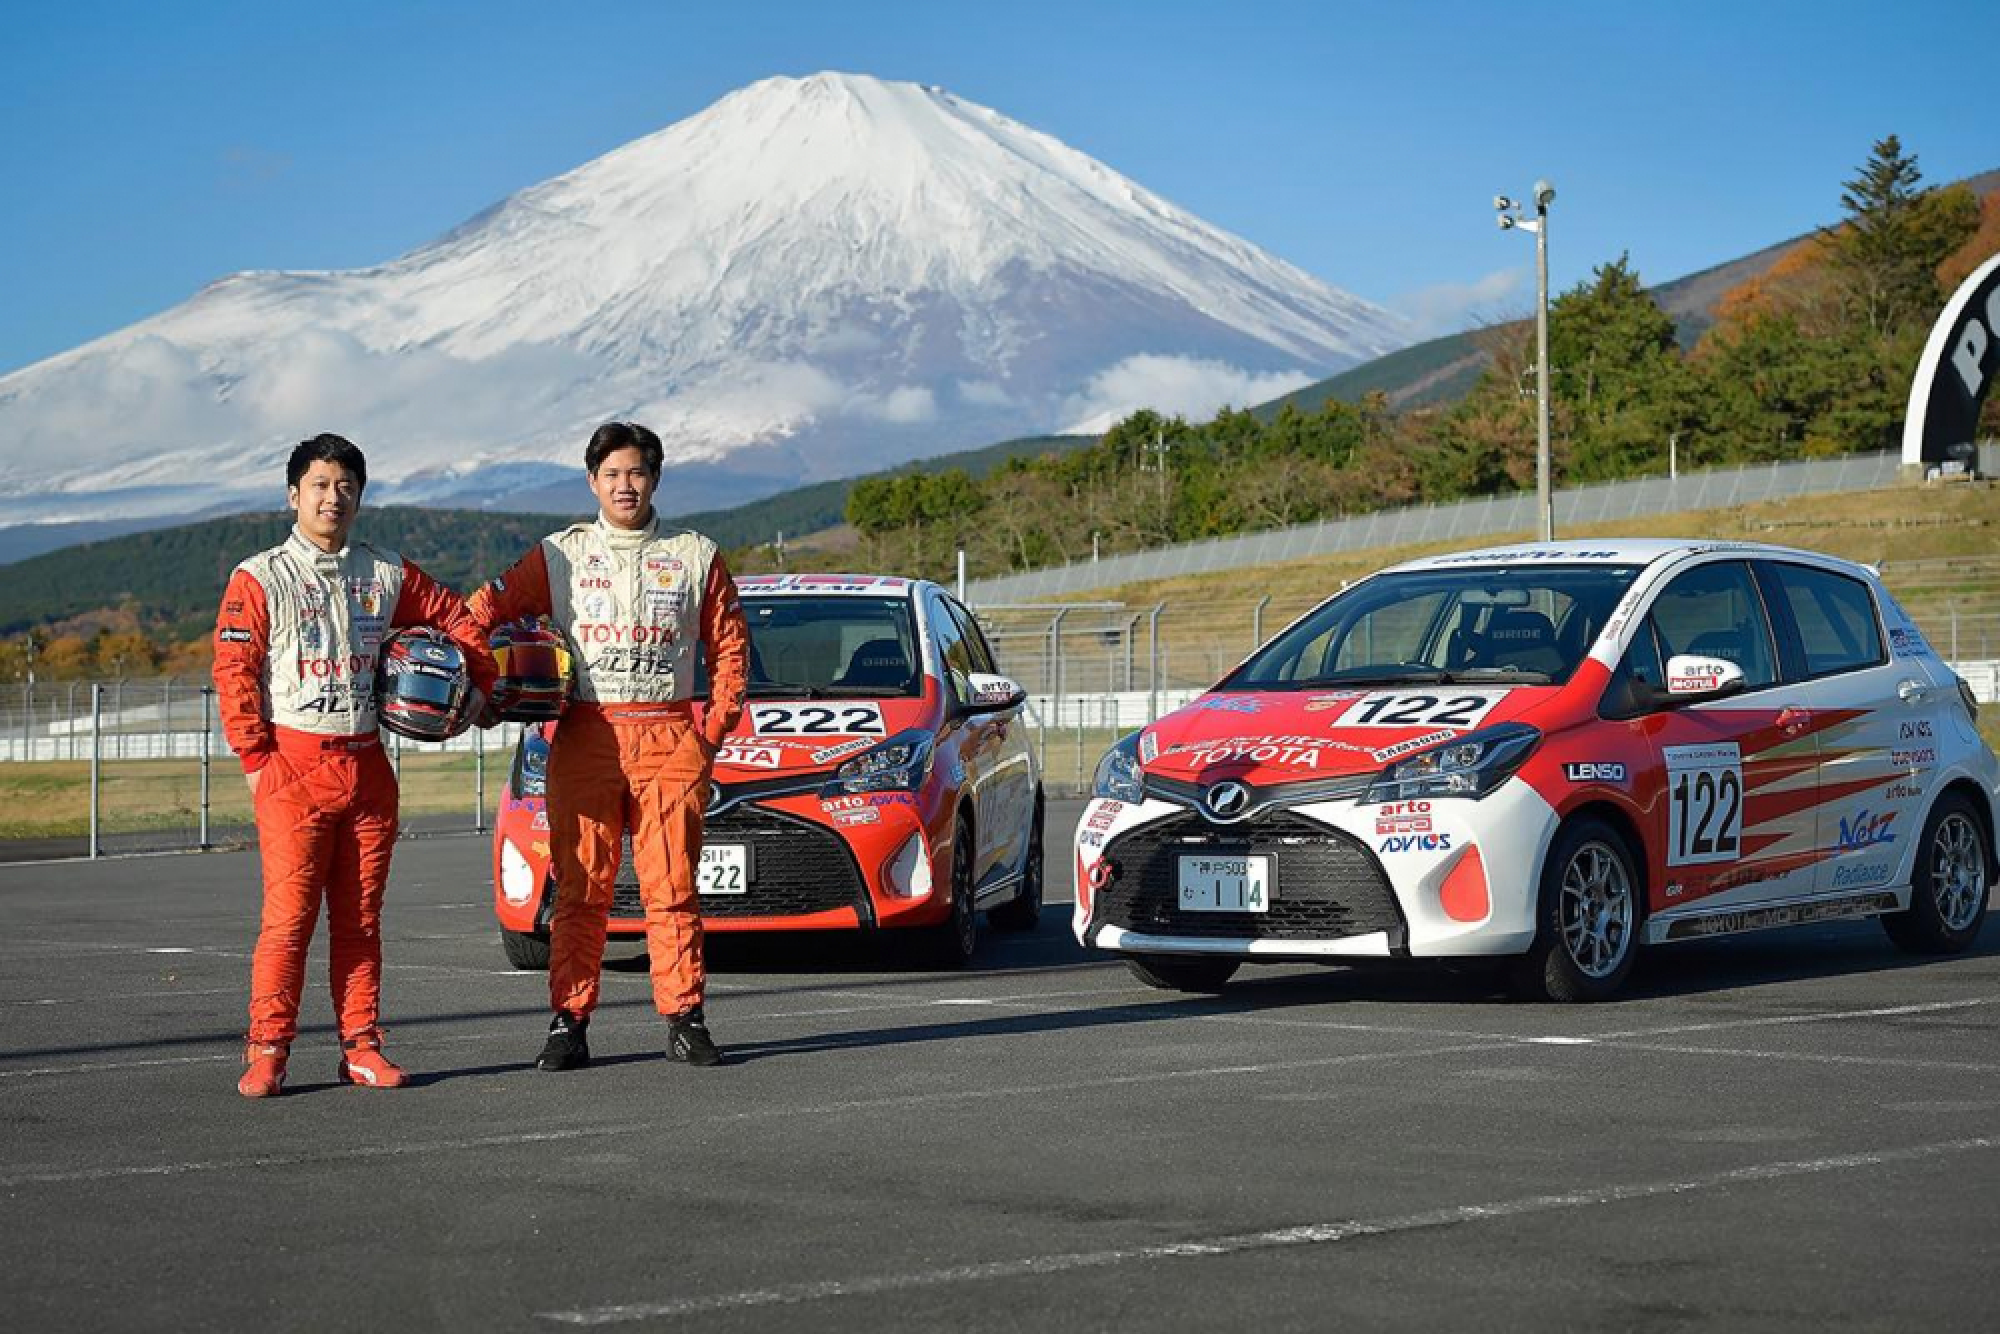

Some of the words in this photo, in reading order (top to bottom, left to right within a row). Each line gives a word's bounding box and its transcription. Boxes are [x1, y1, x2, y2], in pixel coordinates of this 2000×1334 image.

[579, 577, 613, 589] arto
[578, 622, 674, 646] TOYOTA
[585, 656, 674, 674] ALTIS
[1683, 664, 1725, 677] arto
[1670, 676, 1717, 690] MOTUL
[1356, 695, 1488, 724] 122
[755, 709, 883, 733] 222
[1376, 729, 1456, 762] SAMSUNG
[1188, 745, 1319, 769] TOYOTA
[1568, 764, 1625, 781] LENSO
[821, 798, 863, 812] arto
[1380, 800, 1431, 816] arto
[1672, 770, 1741, 858] 122
[1833, 809, 1899, 850] Netz
[1380, 833, 1451, 853] ADVICS
